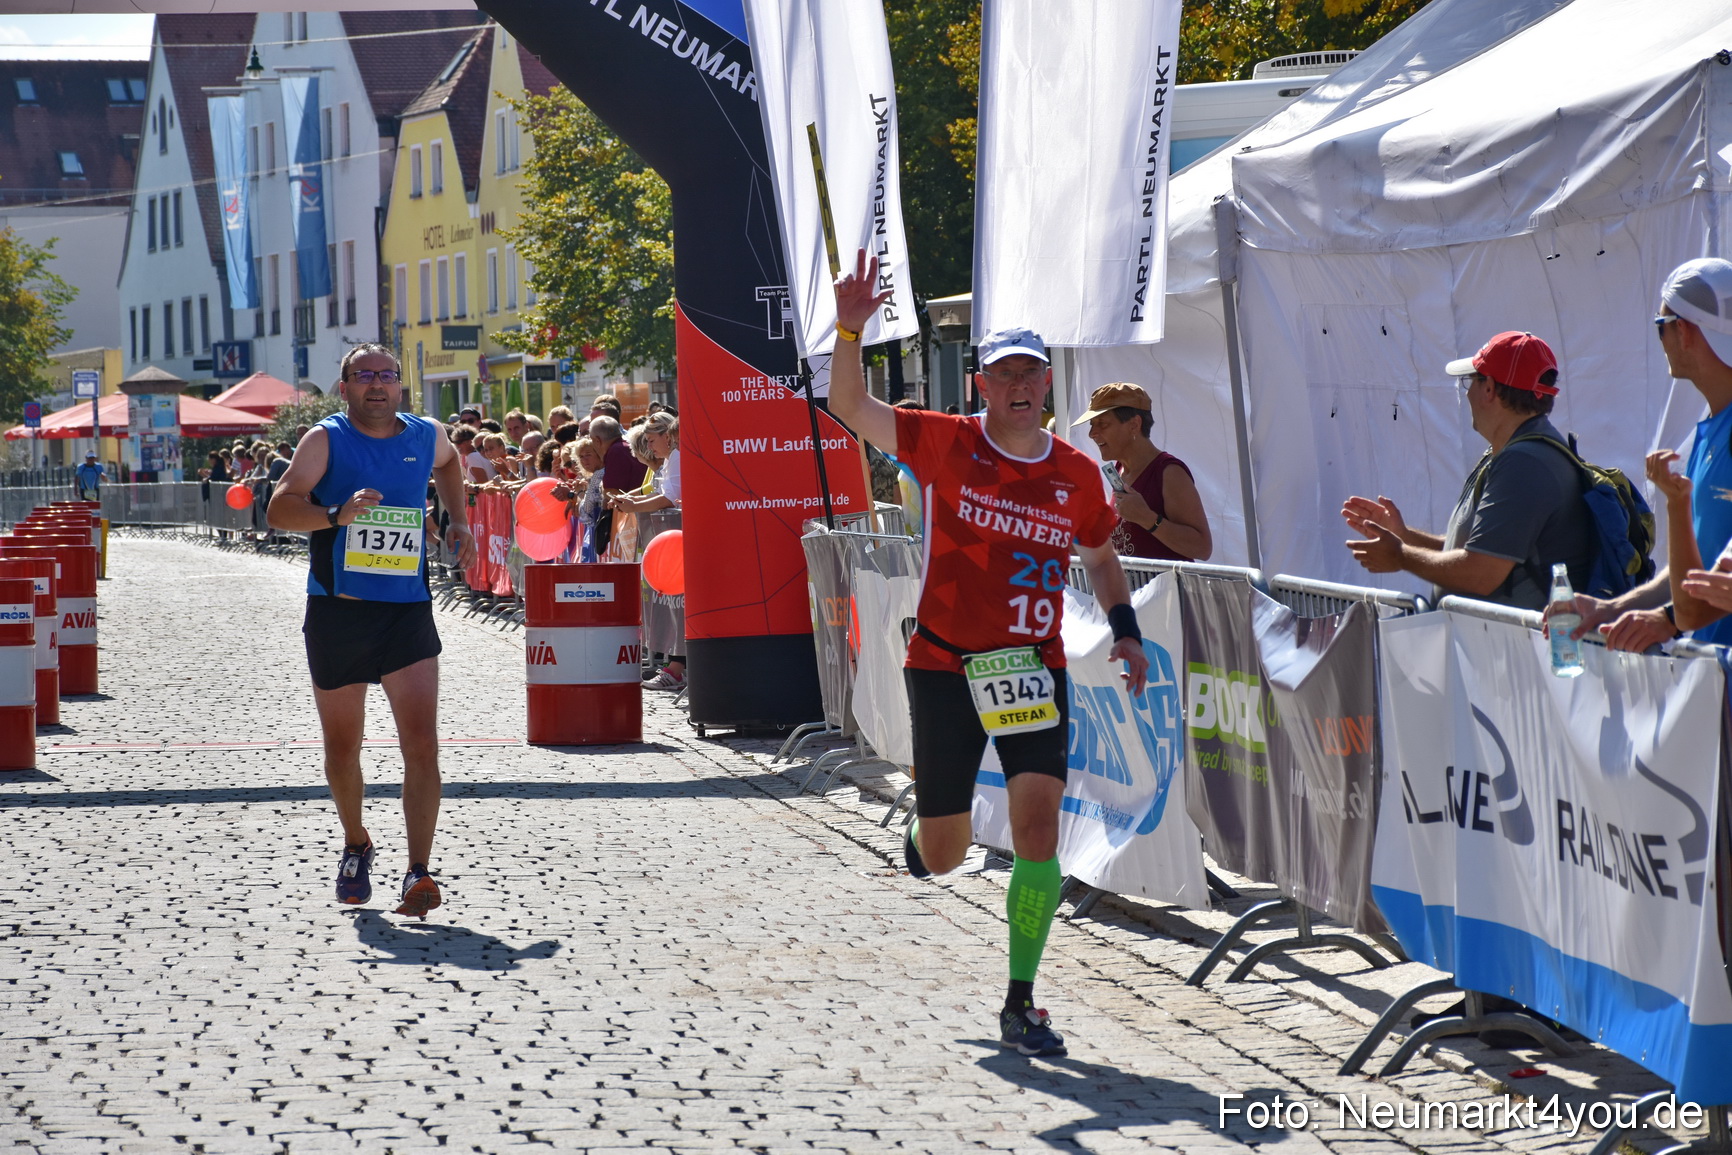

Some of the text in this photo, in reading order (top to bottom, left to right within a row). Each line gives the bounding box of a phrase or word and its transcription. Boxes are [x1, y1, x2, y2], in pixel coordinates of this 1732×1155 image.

[1130, 46, 1172, 323] PARTL NEUMARKT
[868, 93, 900, 323] PARTL NEUMARKT
[423, 224, 446, 251] HOTEL
[424, 350, 456, 369] Restaurant
[740, 374, 800, 389] THE NEXT
[721, 387, 785, 403] 100 YEARS
[722, 435, 848, 455] BMW Laufsport
[725, 493, 850, 511] www.bmw-parl.de
[960, 485, 1073, 528] MediaMarktSaturn
[355, 509, 417, 527] BOCK
[957, 500, 1071, 549] RUNNERS
[357, 528, 414, 553] 1374
[365, 553, 402, 568] JENS
[1008, 594, 1055, 638] 19
[973, 653, 1035, 677] BOCK
[983, 676, 1049, 707] 1342
[999, 707, 1048, 725] STEFAN
[1188, 672, 1267, 742] BOCK
